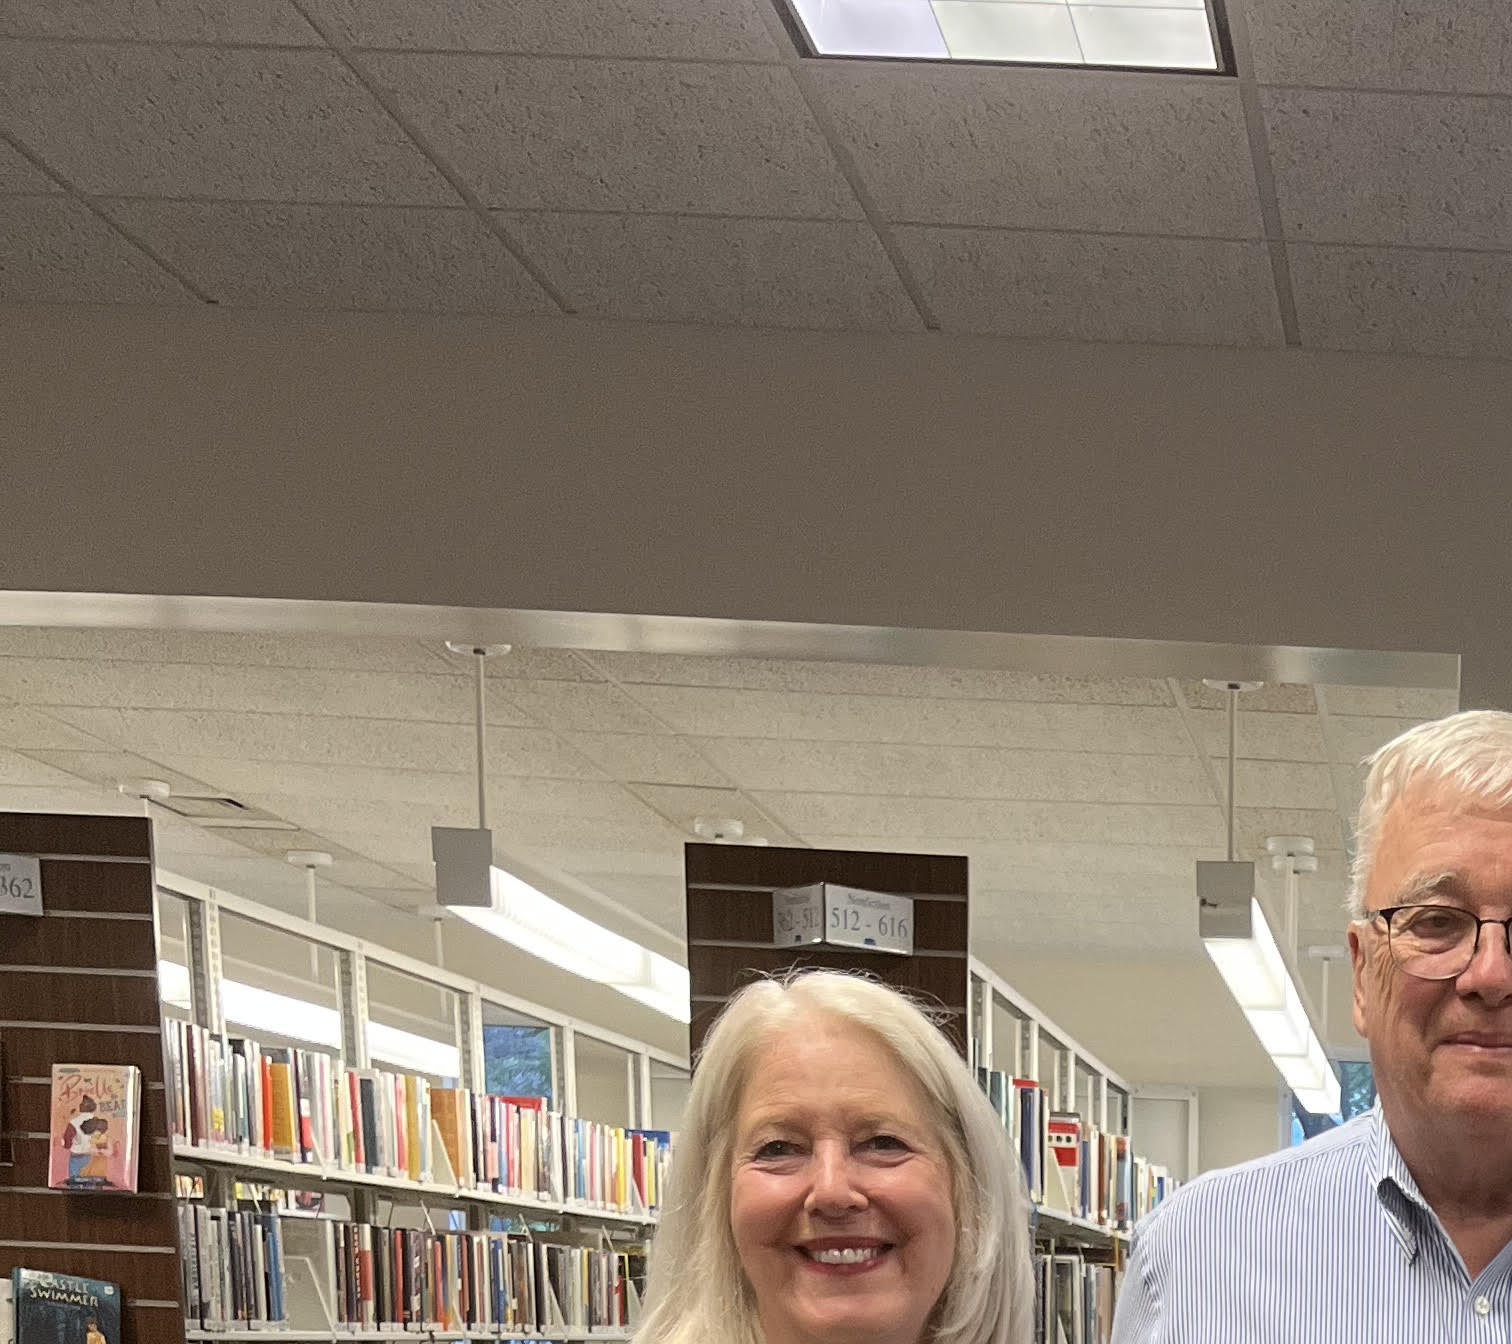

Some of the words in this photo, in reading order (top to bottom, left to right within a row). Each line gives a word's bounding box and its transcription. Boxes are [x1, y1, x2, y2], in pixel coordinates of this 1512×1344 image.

[831, 907, 860, 931] 512
[878, 915, 908, 937] 616
[30, 1286, 98, 1308] SWIMMER
